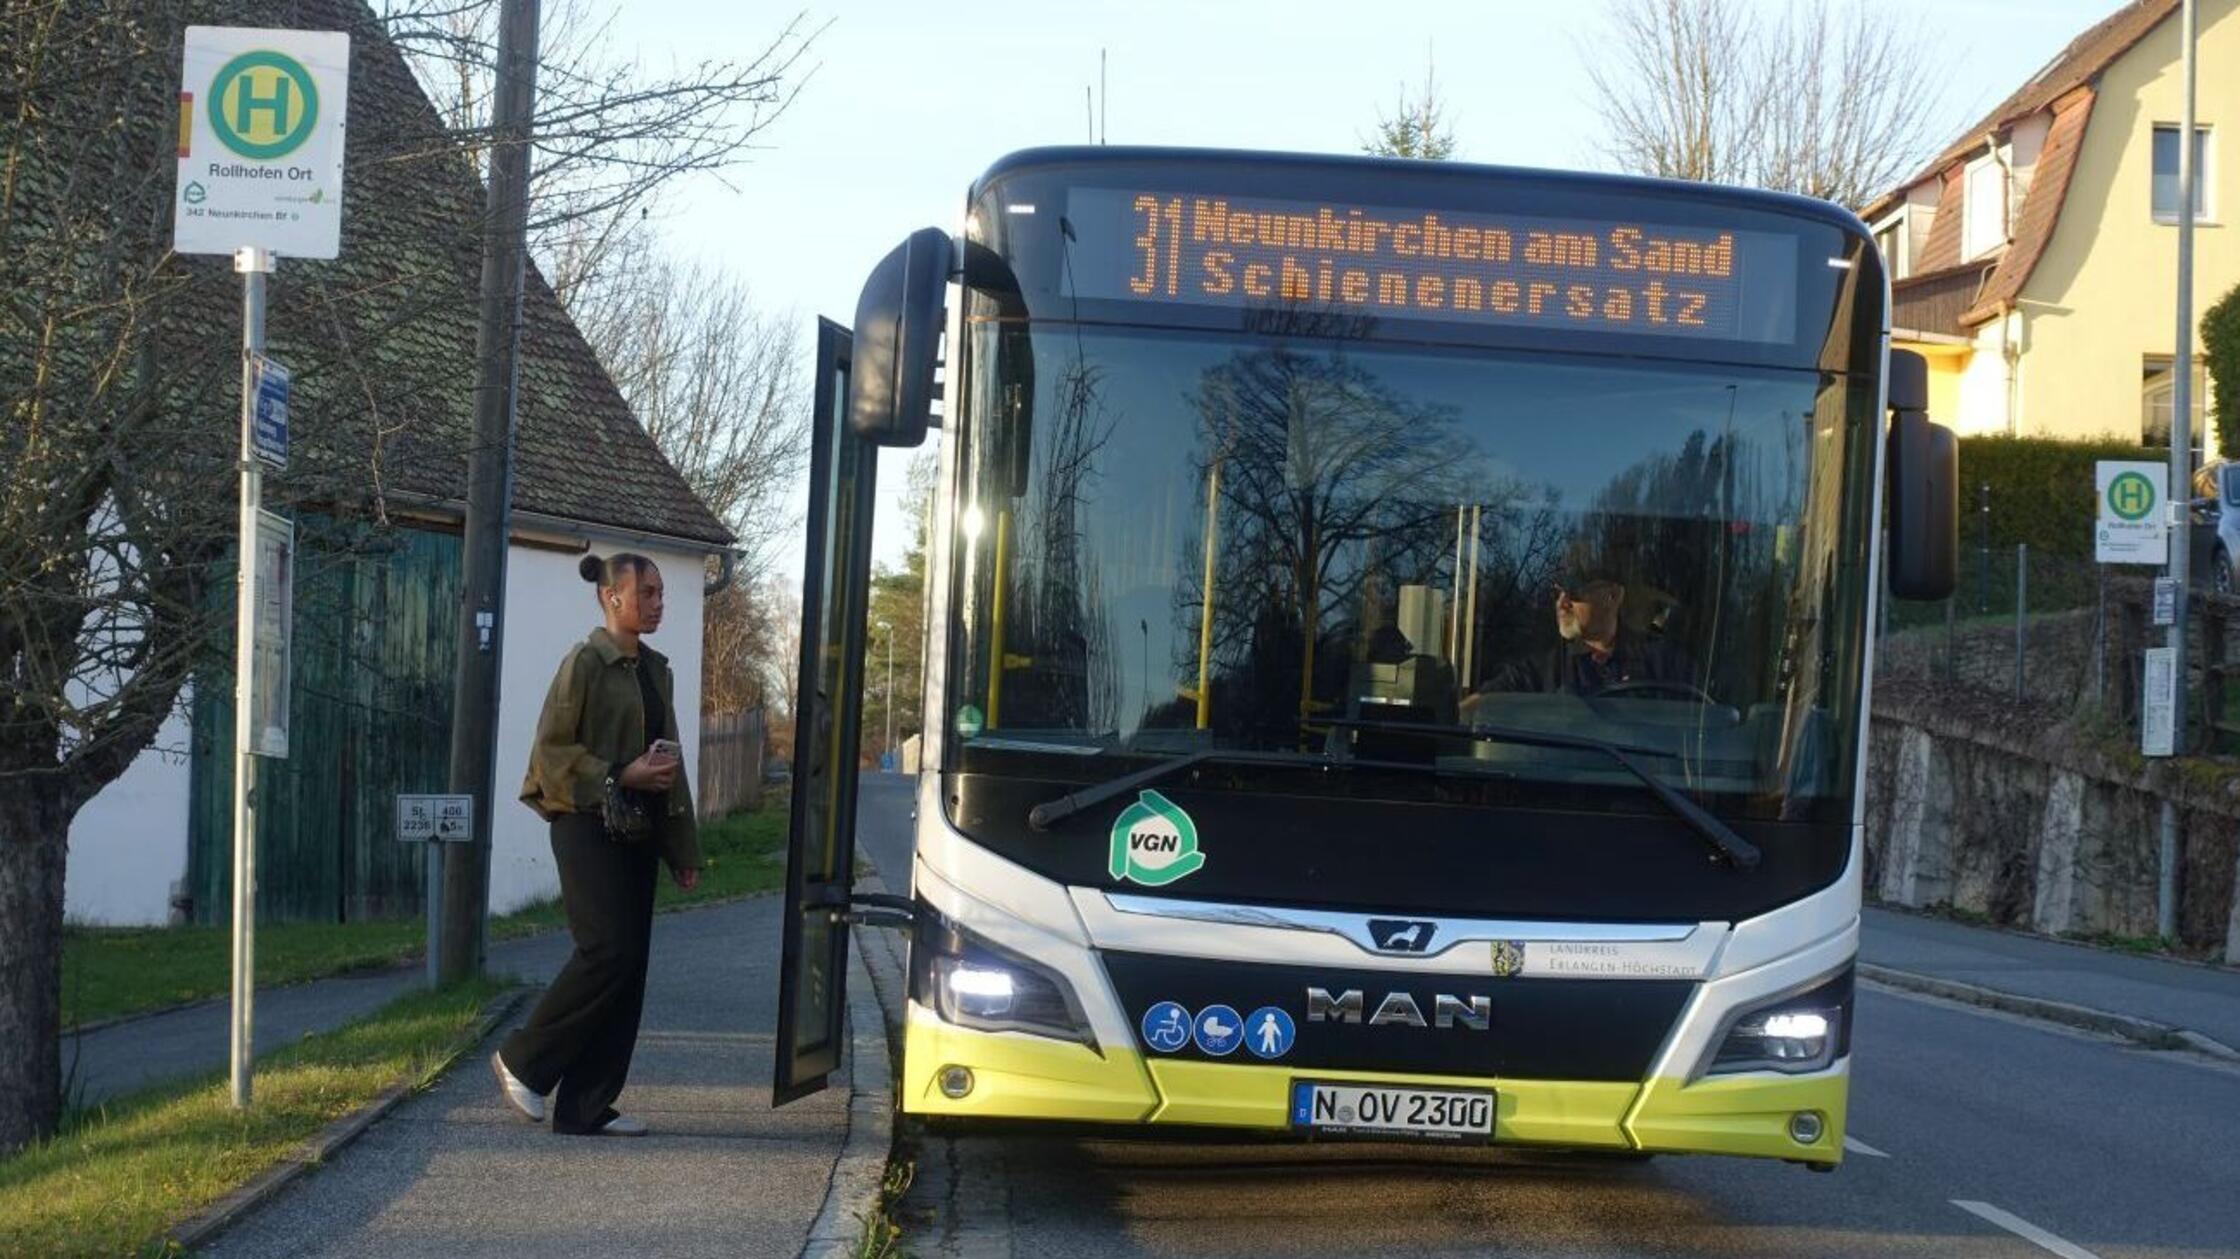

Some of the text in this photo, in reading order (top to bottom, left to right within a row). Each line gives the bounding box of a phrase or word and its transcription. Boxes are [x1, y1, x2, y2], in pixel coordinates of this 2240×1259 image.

[236, 75, 290, 135] H
[208, 163, 313, 181] Rollhofen Ort
[186, 207, 205, 217] 342
[208, 208, 273, 221] Neunkirchen
[1130, 195, 1733, 296] 31 Neunkirchen am Sand
[1202, 250, 1707, 326] Schienenersatz
[1130, 832, 1179, 852] VGN
[1549, 944, 1620, 957] LANDKREIS
[1307, 986, 1492, 1031] MAN
[1315, 1090, 1489, 1128] N OV 2300
